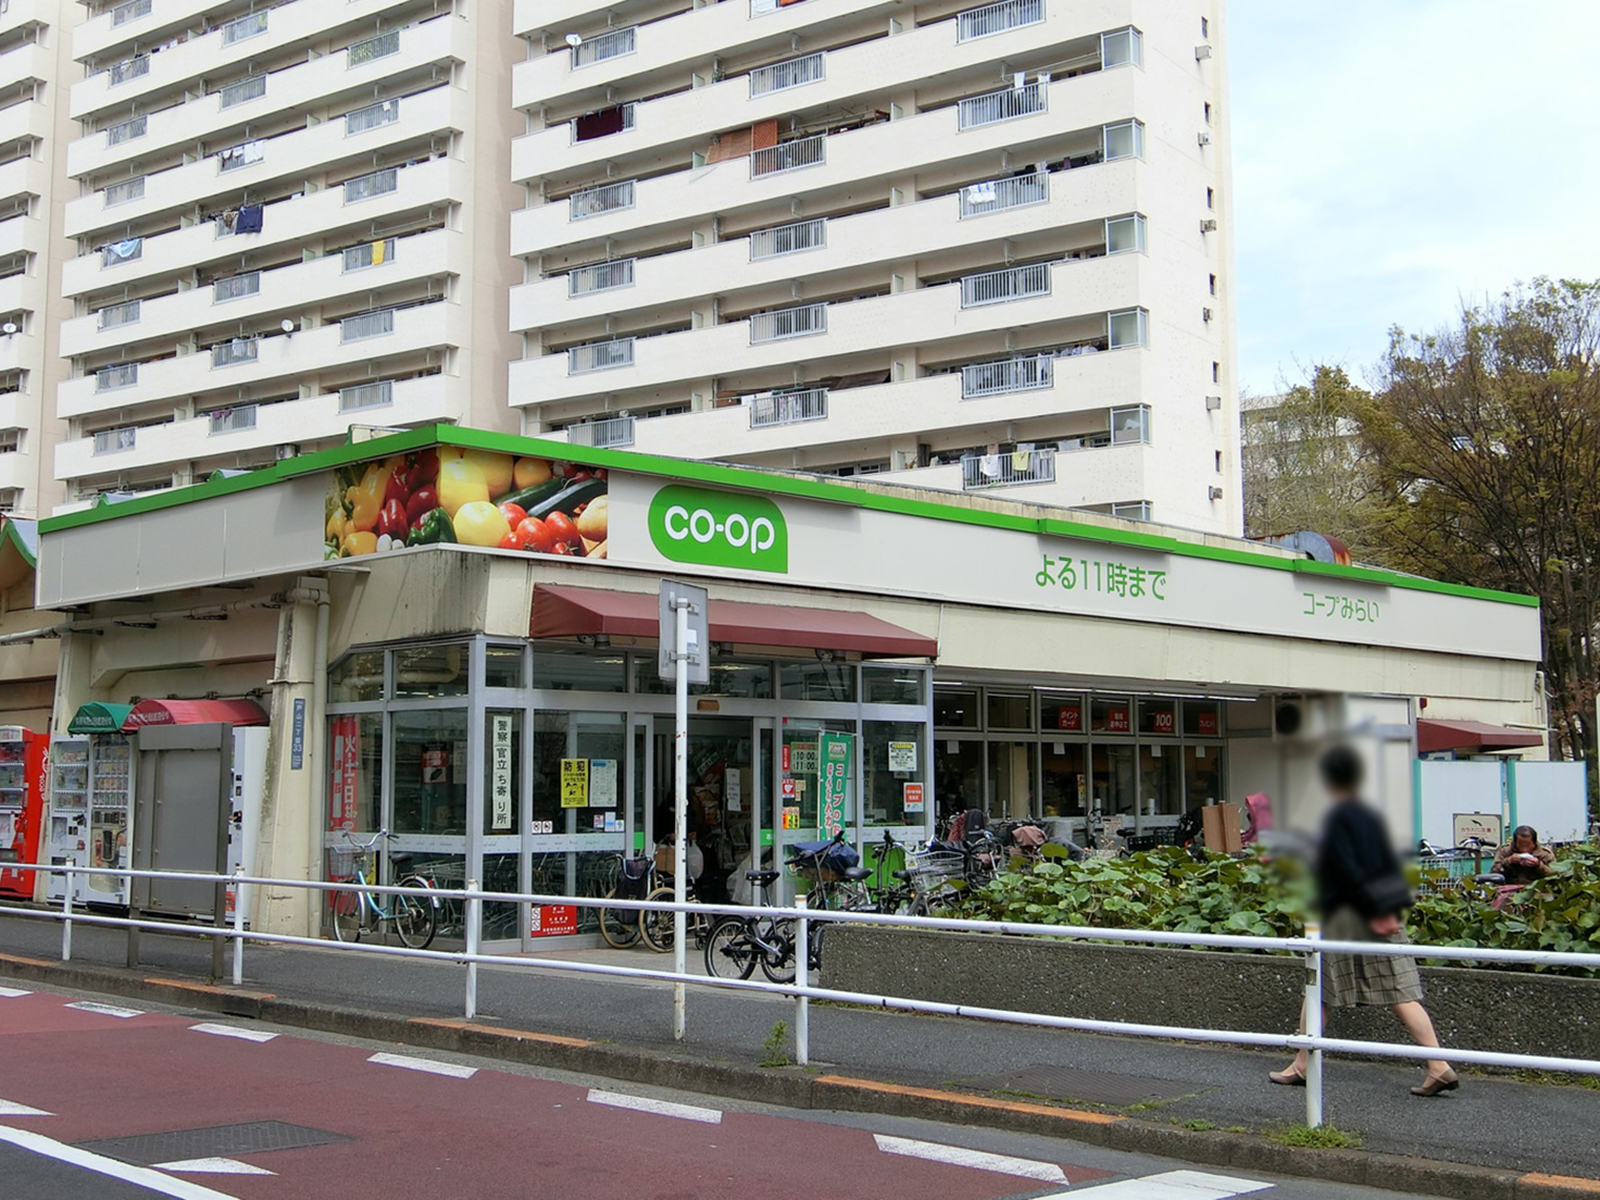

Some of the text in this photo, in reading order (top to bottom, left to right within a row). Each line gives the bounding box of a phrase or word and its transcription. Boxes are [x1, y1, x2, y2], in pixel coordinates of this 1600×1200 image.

[1035, 554, 1167, 601] よる11時まで
[1303, 593, 1379, 622] コープみらい
[1156, 714, 1172, 726] 100
[496, 720, 508, 825] 警察官立ち寄り所
